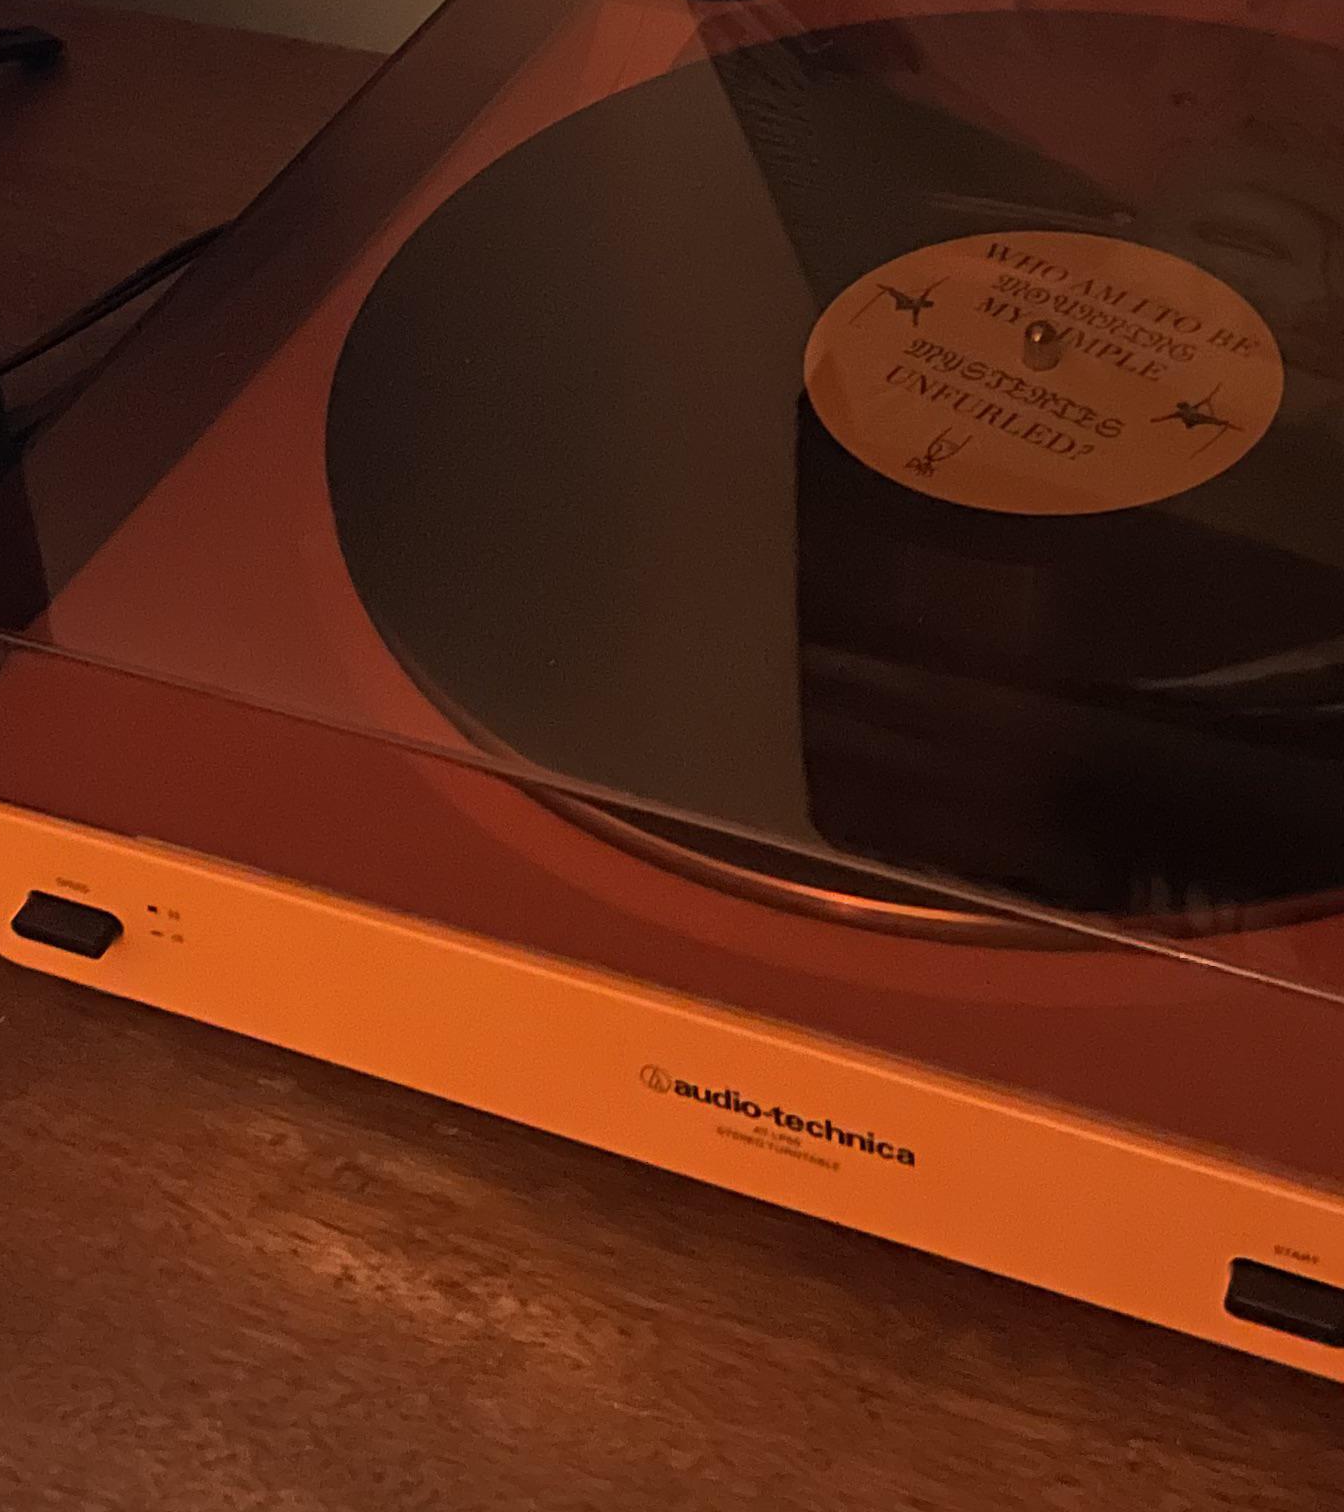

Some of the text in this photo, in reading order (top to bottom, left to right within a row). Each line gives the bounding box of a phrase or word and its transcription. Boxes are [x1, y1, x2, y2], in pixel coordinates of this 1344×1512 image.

[977, 296, 1031, 325] MY
[986, 242, 1069, 281] WHO
[1072, 279, 1127, 307] AM
[1154, 306, 1202, 334] TO
[1208, 328, 1261, 358] BE
[886, 365, 1095, 460] UNFURLED?
[673, 1078, 916, 1168] audio-technica
